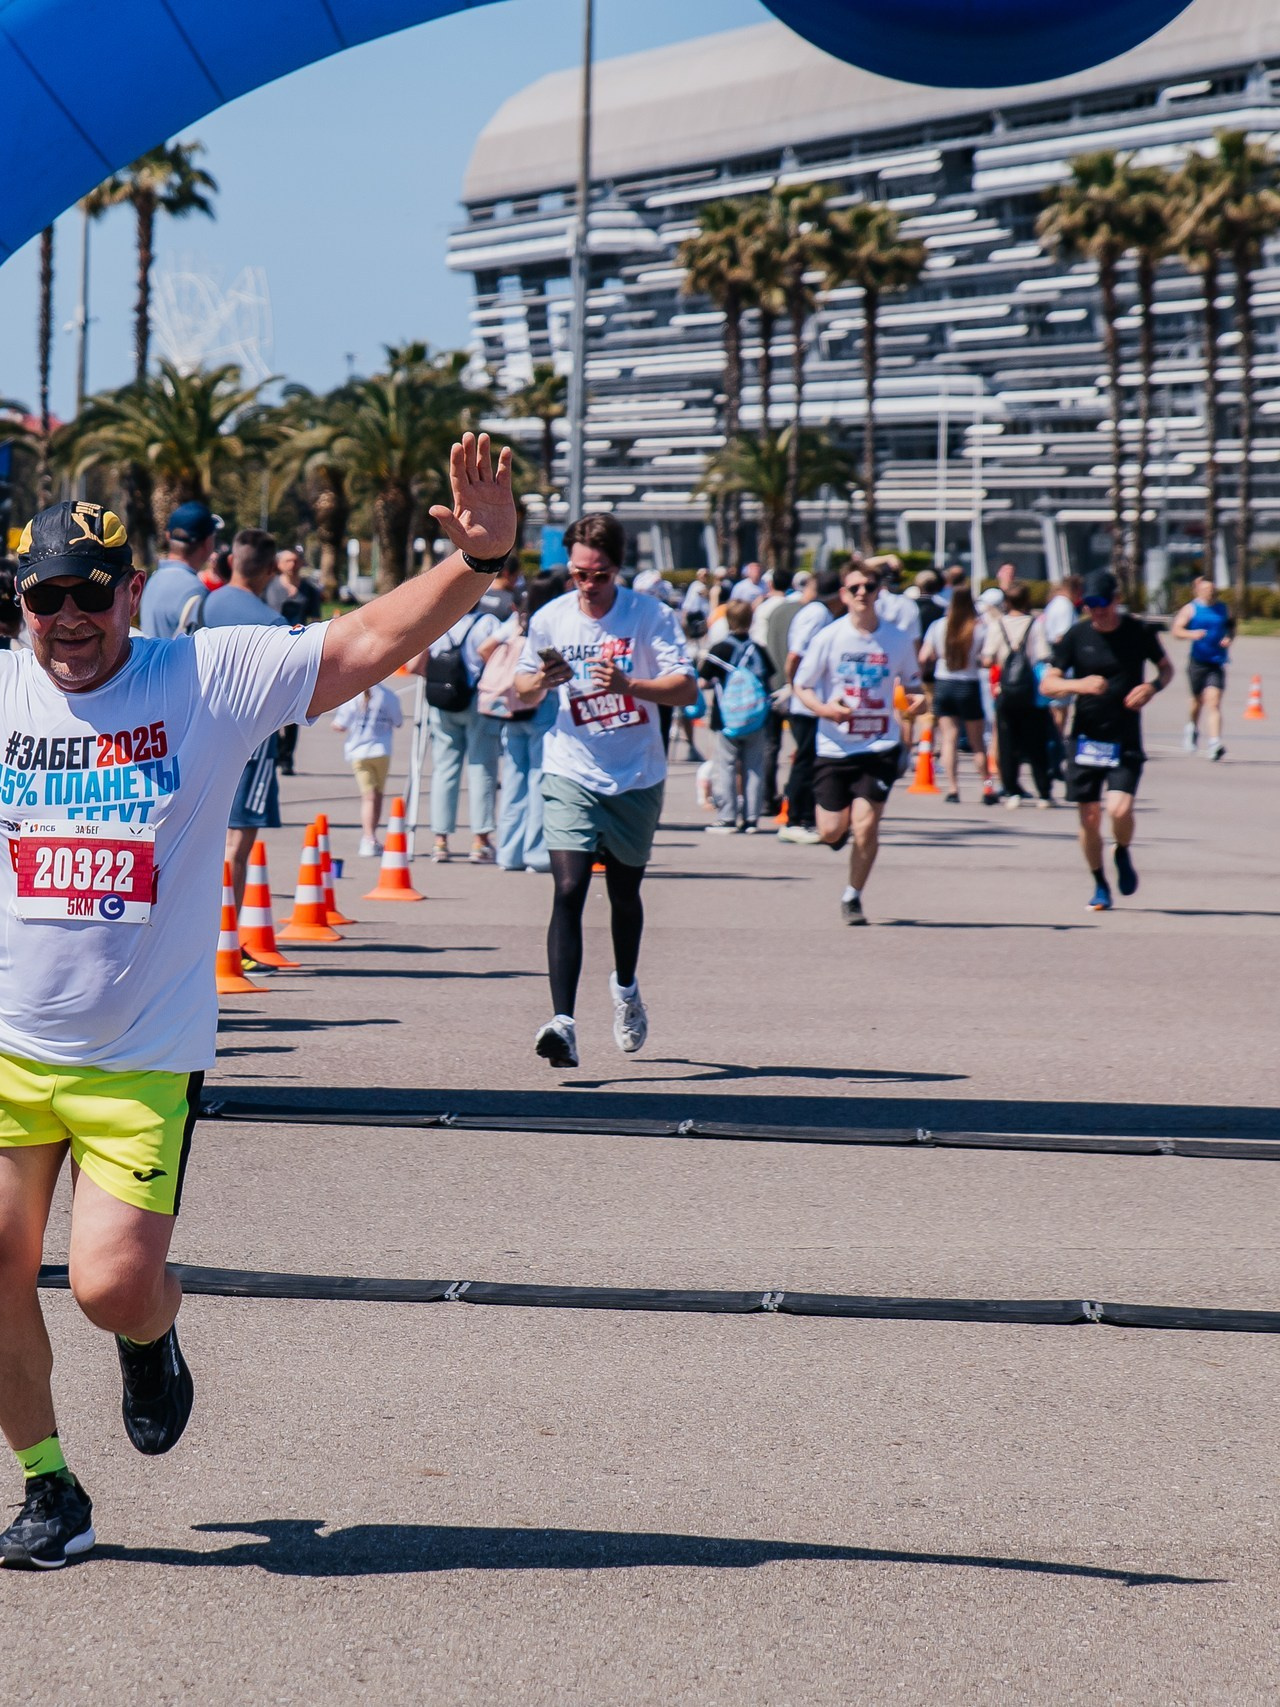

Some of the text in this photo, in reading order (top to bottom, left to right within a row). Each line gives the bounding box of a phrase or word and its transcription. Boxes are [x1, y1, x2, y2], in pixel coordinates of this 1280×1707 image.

[44, 754, 181, 806] ПЛАНЕТЫ
[39, 824, 56, 832] ПСБ
[33, 847, 135, 893] 20322
